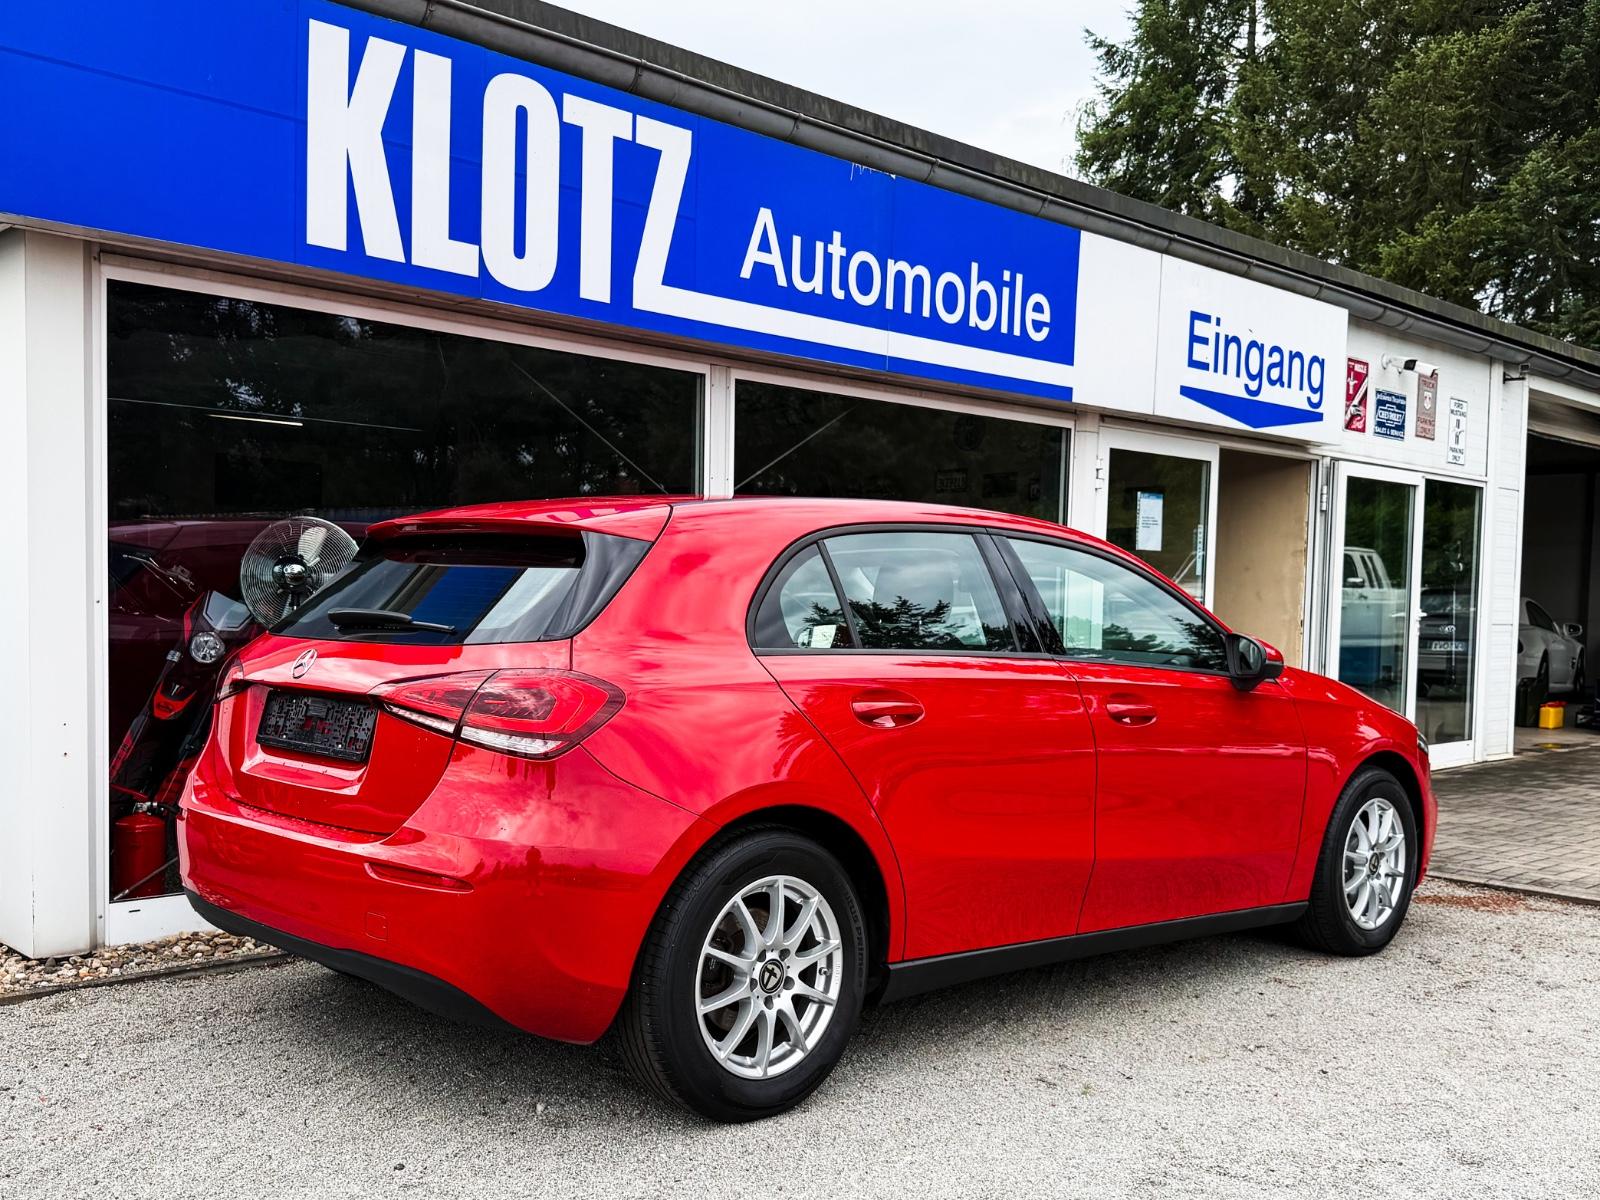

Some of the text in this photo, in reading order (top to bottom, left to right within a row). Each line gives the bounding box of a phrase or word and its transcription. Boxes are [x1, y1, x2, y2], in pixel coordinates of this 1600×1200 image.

[306, 19, 693, 318] KLOTZ
[739, 207, 1052, 343] Automobile
[1187, 310, 1326, 410] Eingang
